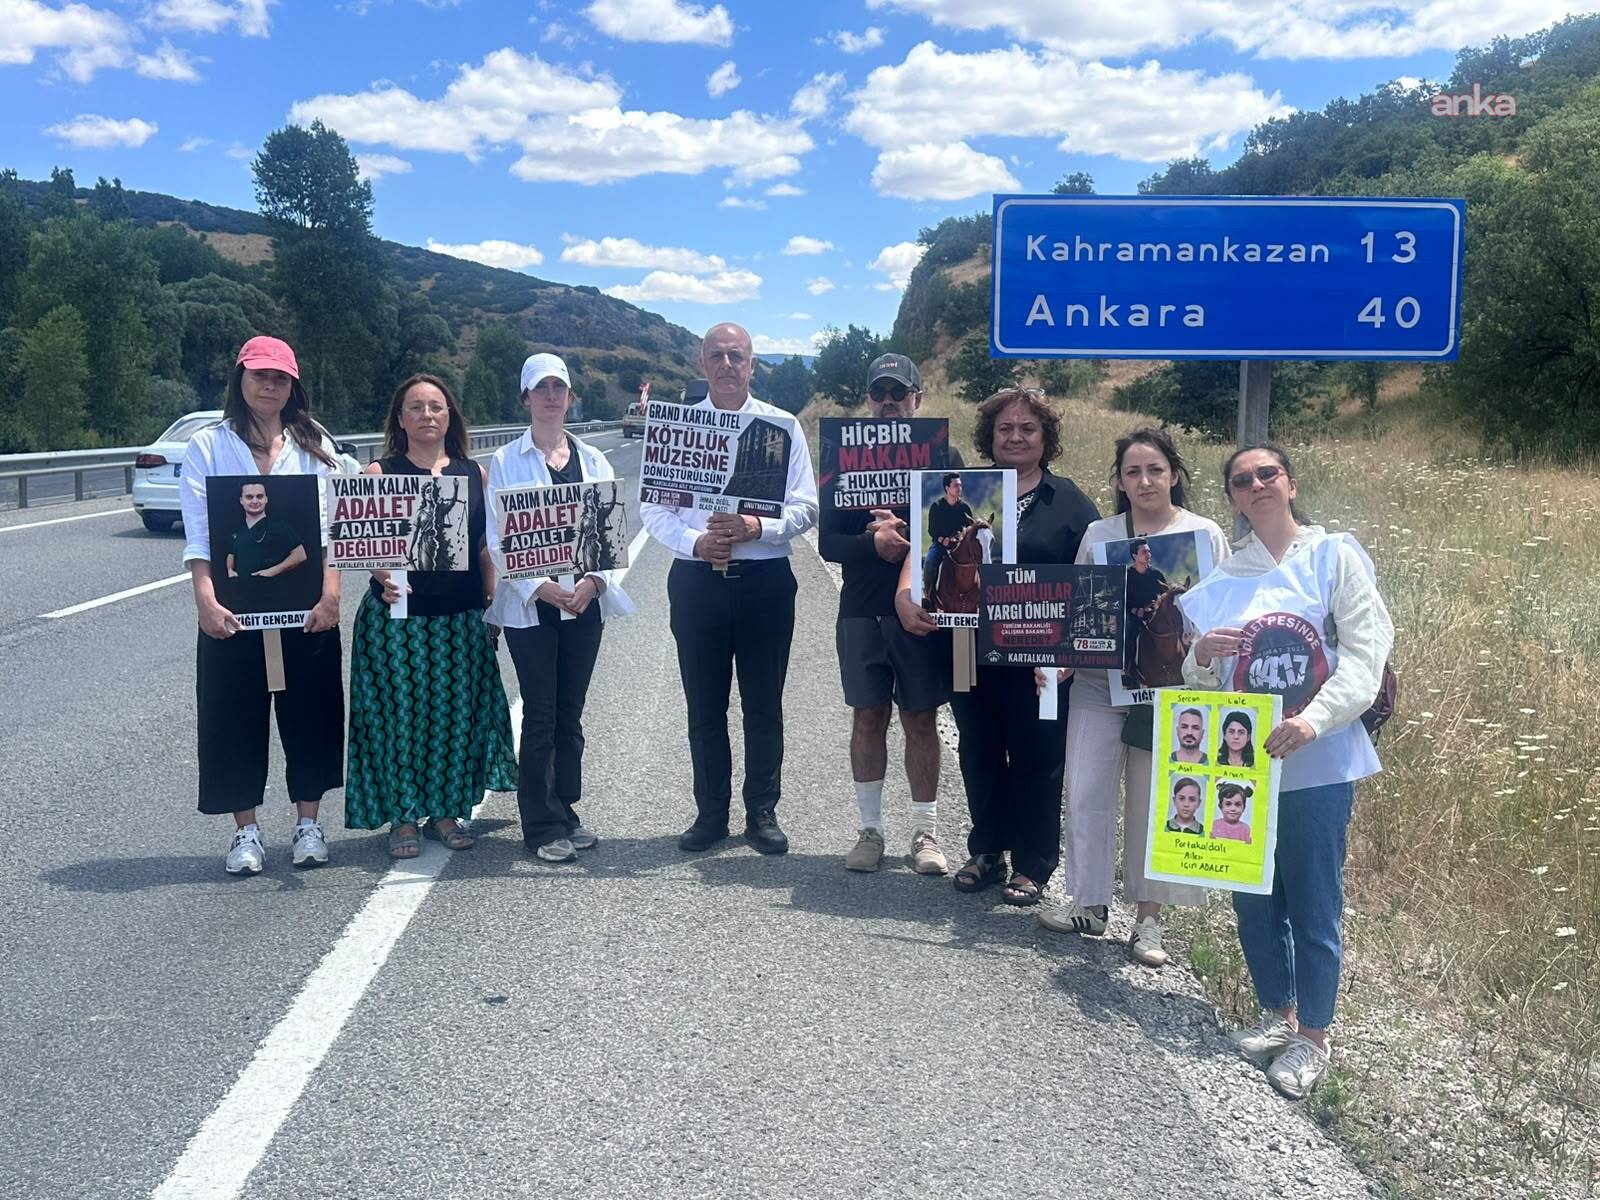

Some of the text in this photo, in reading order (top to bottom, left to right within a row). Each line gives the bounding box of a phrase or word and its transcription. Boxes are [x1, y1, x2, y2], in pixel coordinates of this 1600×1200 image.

[1026, 232, 1416, 264] Kahramankazan 13
[1025, 294, 1421, 328] Ankara 40
[649, 404, 740, 429] GRAND KARTAL OTEL
[647, 424, 730, 453] KÖTÜLÜK
[841, 420, 912, 450] HİÇBİR
[645, 444, 729, 472] MÜZESİNE
[838, 442, 931, 472] MAKAM
[332, 477, 420, 496] YARIM KALAN
[646, 488, 660, 503] 78
[334, 496, 416, 521] ADALET
[500, 484, 581, 512] YARIM KALAN
[834, 488, 910, 508] ÜSTÜN DEĞİ
[340, 520, 402, 538] ADALET
[504, 504, 578, 536] ADALET
[334, 537, 407, 558] DEĞİLDİR
[510, 528, 566, 551] ADALET
[506, 544, 572, 570] DEĞİLDİR
[1006, 568, 1036, 584] TÜM
[986, 582, 1072, 602] SORUMLULAR
[262, 613, 304, 626] GENÇBAY
[986, 601, 1065, 620] YARGI ÖNÜNE
[1076, 640, 1088, 649] 78
[1008, 652, 1055, 663] KARTALKAYA
[1200, 863, 1230, 872] ADALET
